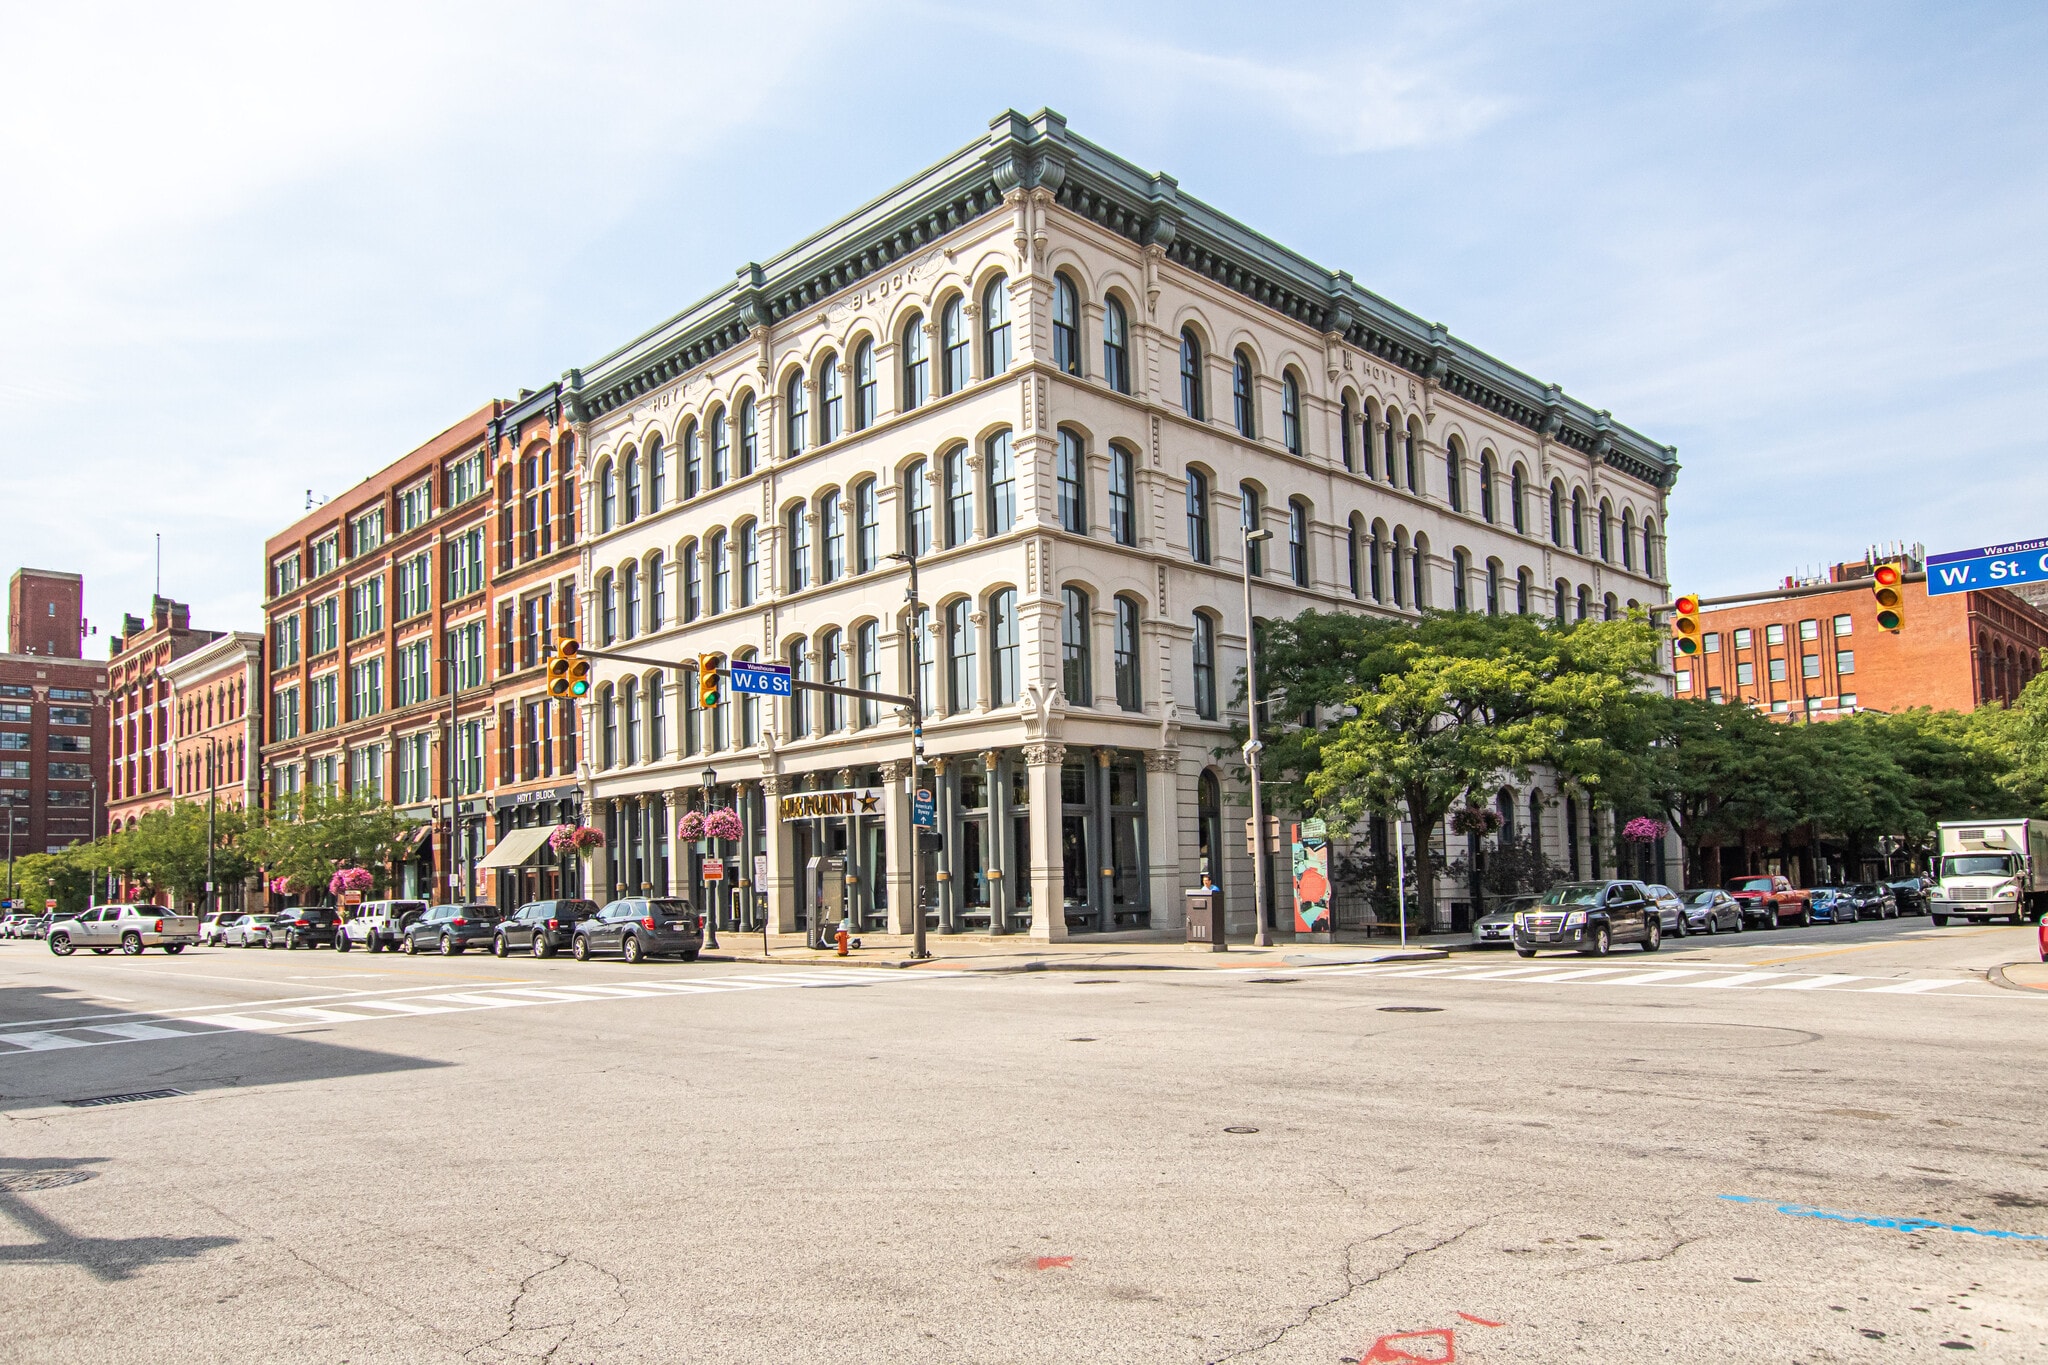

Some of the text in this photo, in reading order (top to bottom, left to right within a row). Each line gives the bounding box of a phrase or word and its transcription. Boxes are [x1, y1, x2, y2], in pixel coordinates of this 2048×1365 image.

[851, 266, 920, 311] BLOCK
[1363, 361, 1398, 387] HOYT
[652, 383, 687, 412] HOYT
[1939, 565, 1977, 586] W.
[1989, 560, 2026, 579] St.
[747, 663, 776, 672] Warehouse
[734, 672, 789, 692] W. 6 St
[516, 789, 556, 803] HOYT BLOCK
[804, 791, 857, 816] POINT
